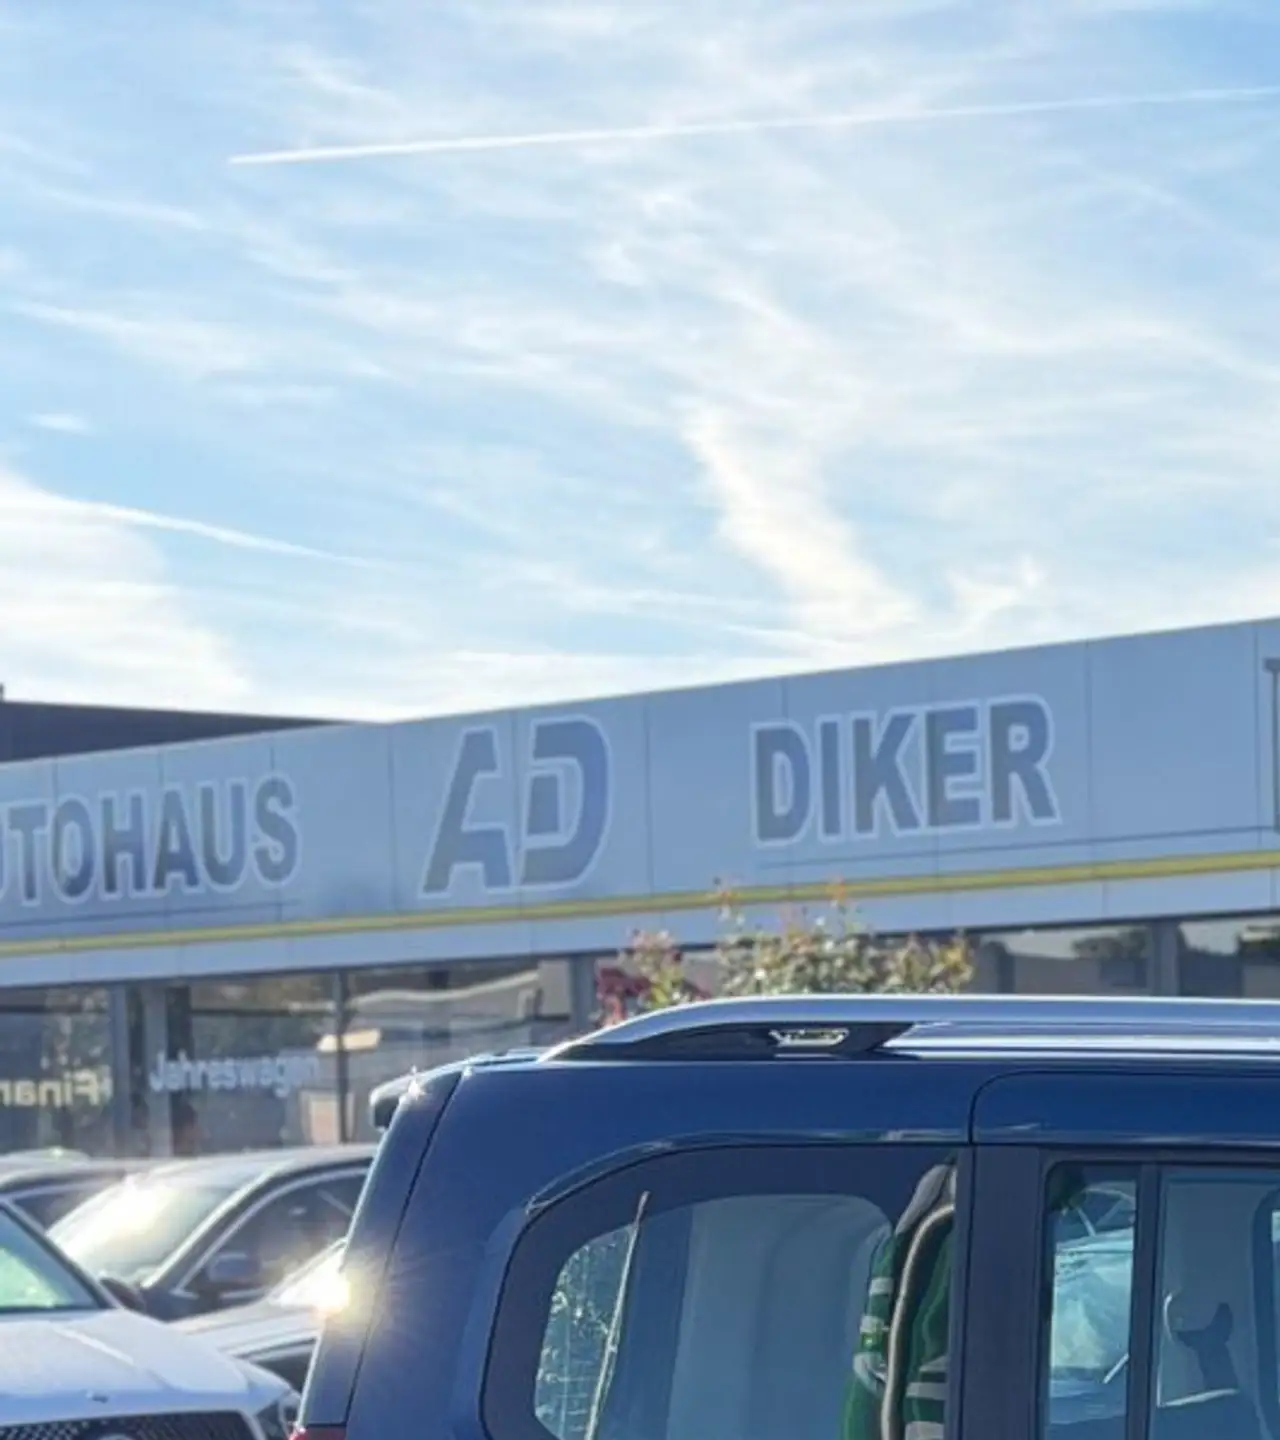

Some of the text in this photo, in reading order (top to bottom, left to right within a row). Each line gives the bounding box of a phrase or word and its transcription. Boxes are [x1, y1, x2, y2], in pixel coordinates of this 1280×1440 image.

[0, 697, 1059, 902] TOHAUS AD DIKER
